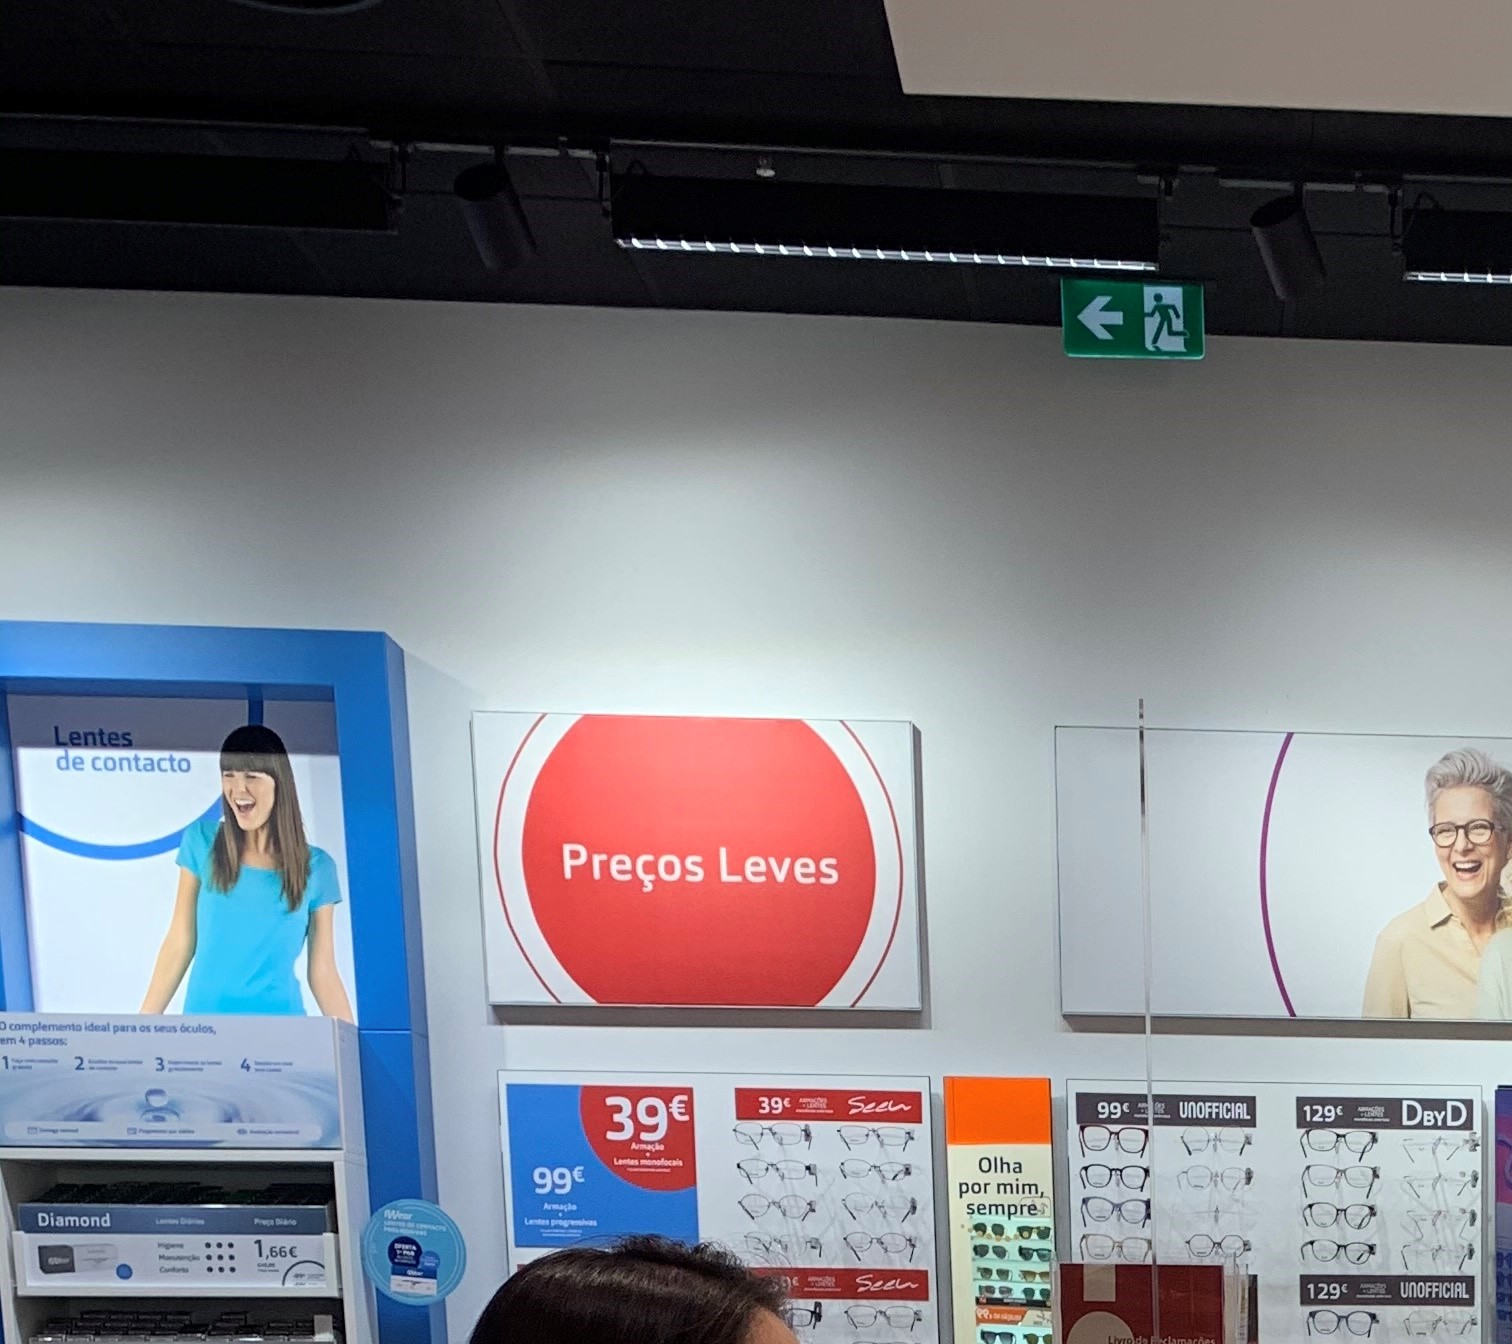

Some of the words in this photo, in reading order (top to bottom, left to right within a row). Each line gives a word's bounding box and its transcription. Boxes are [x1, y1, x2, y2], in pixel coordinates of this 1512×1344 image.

[54, 725, 133, 748] Lentes
[57, 750, 84, 772] de
[91, 752, 191, 773] contacto
[562, 843, 704, 893] Preços
[719, 846, 839, 885] Leves
[9, 1022, 82, 1034] complemento
[84, 1022, 110, 1033] ideal
[113, 1024, 137, 1035] para
[139, 1025, 151, 1033] os
[154, 1025, 177, 1034] seus
[0, 1037, 16, 1046] em
[19, 1036, 25, 1046] 4
[2, 1056, 9, 1070] 1
[75, 1057, 85, 1070] 2
[155, 1057, 165, 1072] 3
[240, 1058, 251, 1072] 4
[759, 1097, 791, 1114] 39€
[1098, 1101, 1130, 1119] 99€
[1179, 1101, 1252, 1119] UNOFFICIAL
[1303, 1105, 1343, 1122] 129€
[605, 1094, 690, 1142] 39€
[631, 1141, 664, 1151] Armação
[614, 1157, 639, 1166] Lentes
[640, 1158, 683, 1167] monofocais
[979, 1156, 1023, 1174] Olha
[533, 1165, 585, 1195] 99€
[959, 1180, 991, 1198] por
[997, 1178, 1045, 1198] mim,
[543, 1202, 577, 1212] Armação
[966, 1202, 1038, 1220] sempre
[38, 1212, 111, 1227] Diamond
[524, 1218, 549, 1227] Lentes
[254, 1239, 298, 1260] 1,66€
[1307, 1283, 1348, 1300] 129€
[1400, 1281, 1470, 1299] UNOFFICIAL
